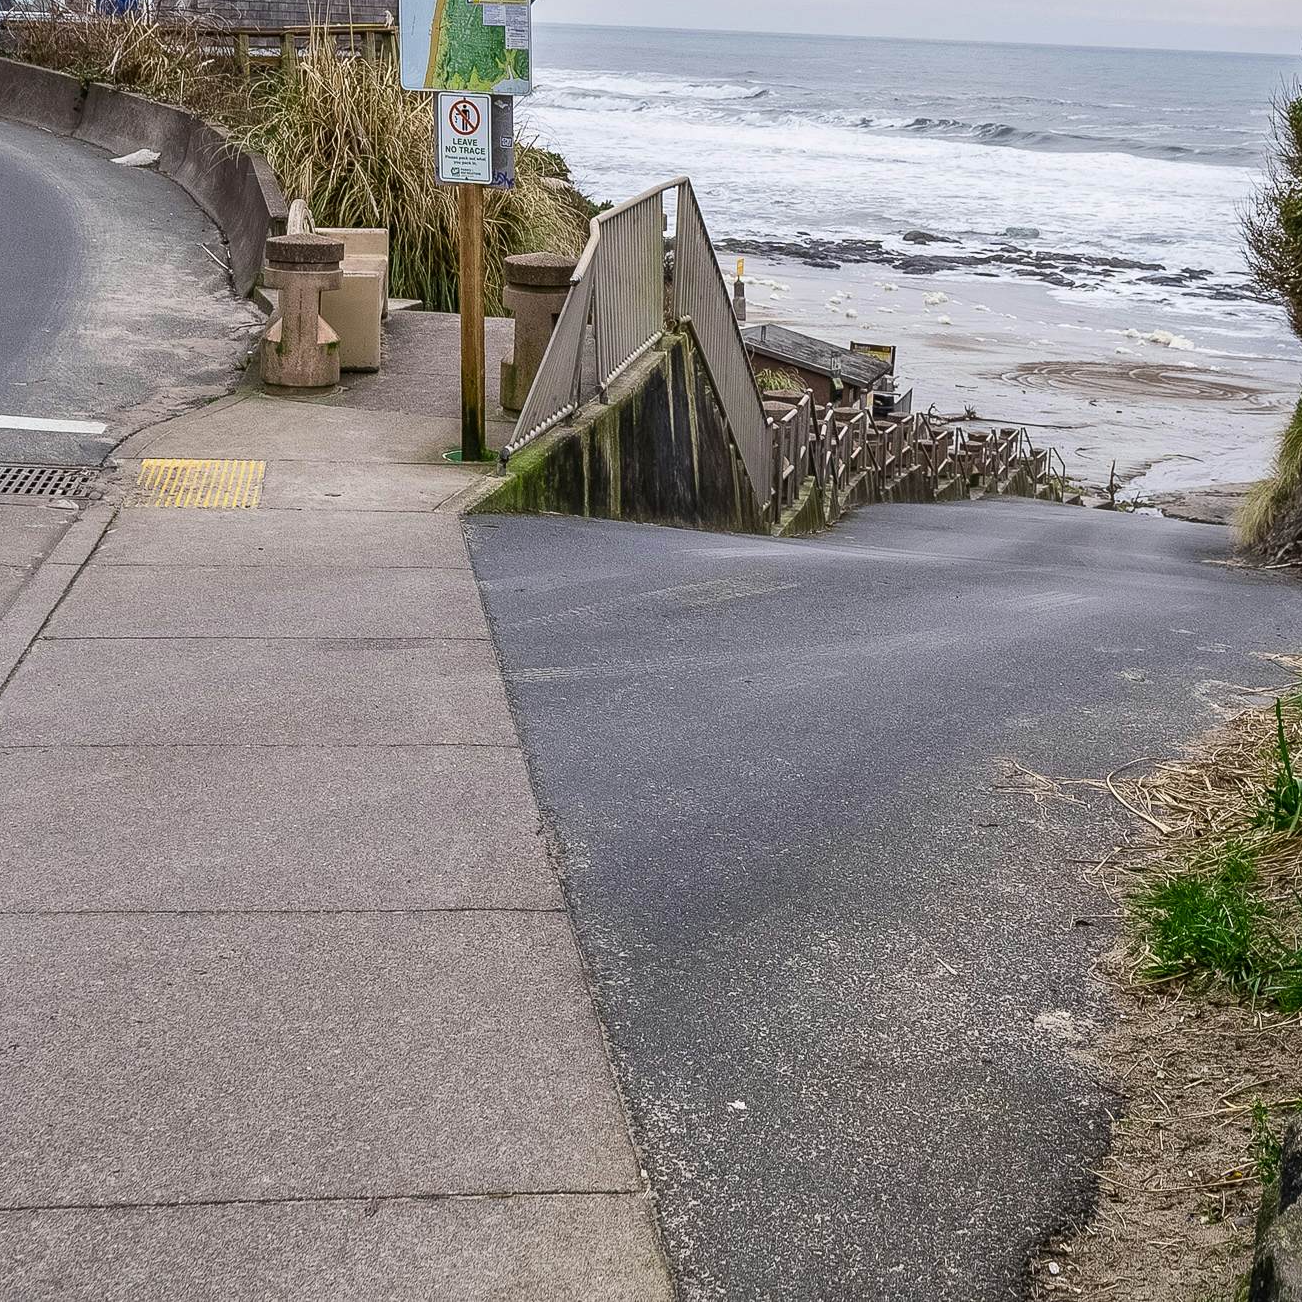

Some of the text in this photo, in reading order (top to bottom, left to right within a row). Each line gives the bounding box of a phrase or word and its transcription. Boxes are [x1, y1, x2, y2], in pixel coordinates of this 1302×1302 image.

[452, 138, 478, 146] LEAVE
[445, 145, 486, 155] NO TRACE
